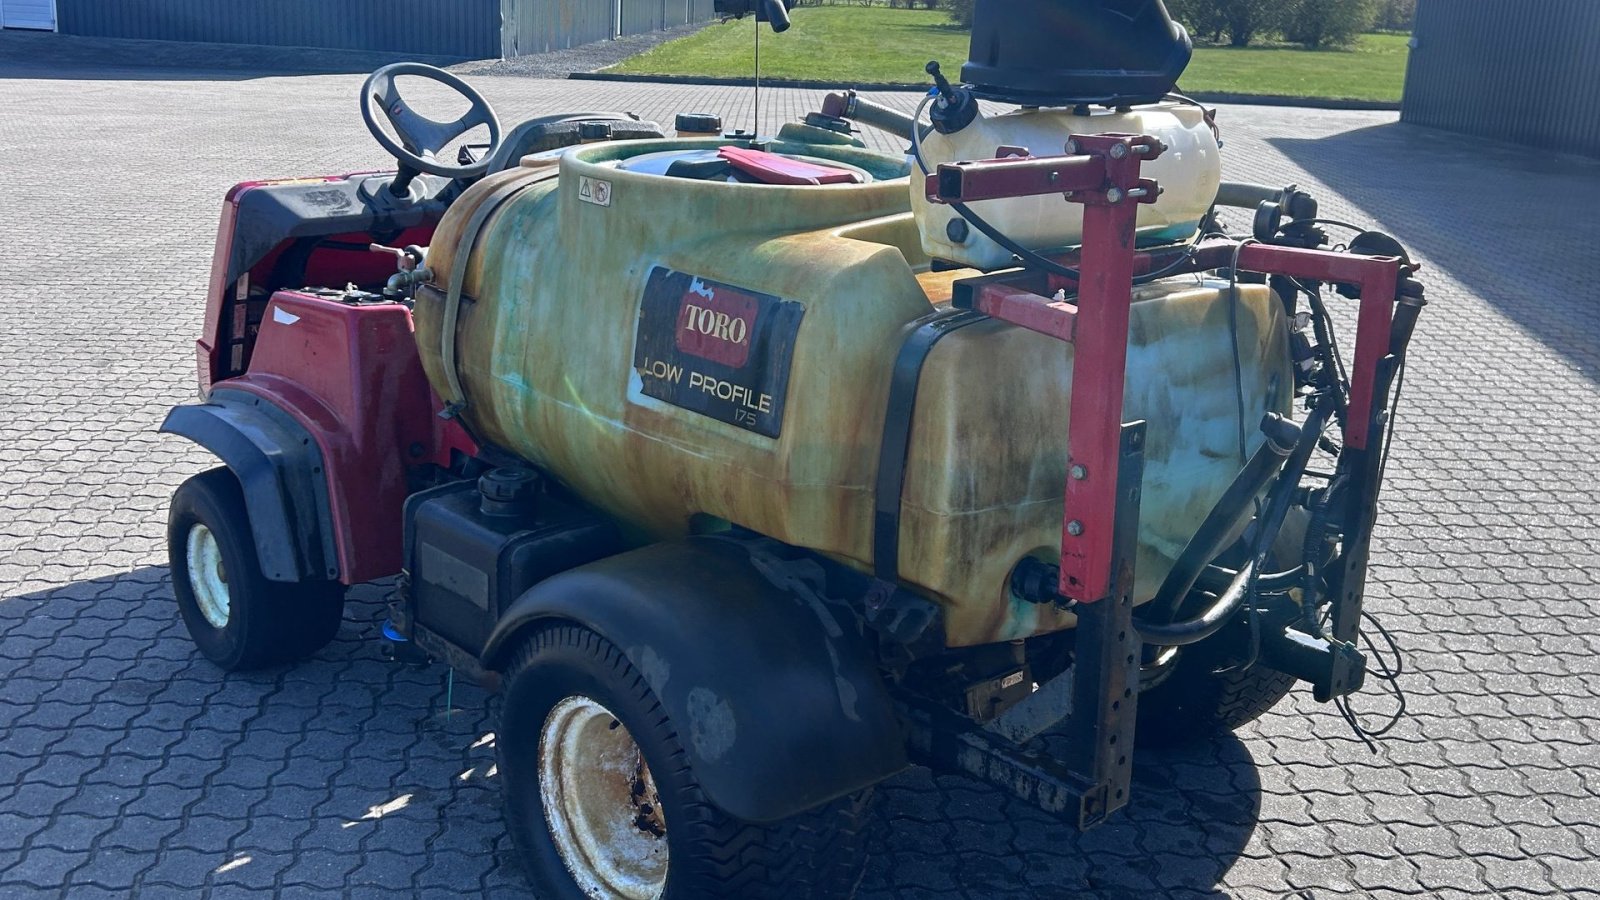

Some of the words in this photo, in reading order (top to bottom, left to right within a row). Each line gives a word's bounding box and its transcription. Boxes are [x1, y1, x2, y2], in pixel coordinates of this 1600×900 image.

[685, 304, 747, 344] TORO
[644, 357, 683, 384] LOW
[689, 372, 772, 413] PROFILE
[735, 408, 757, 426] 175
